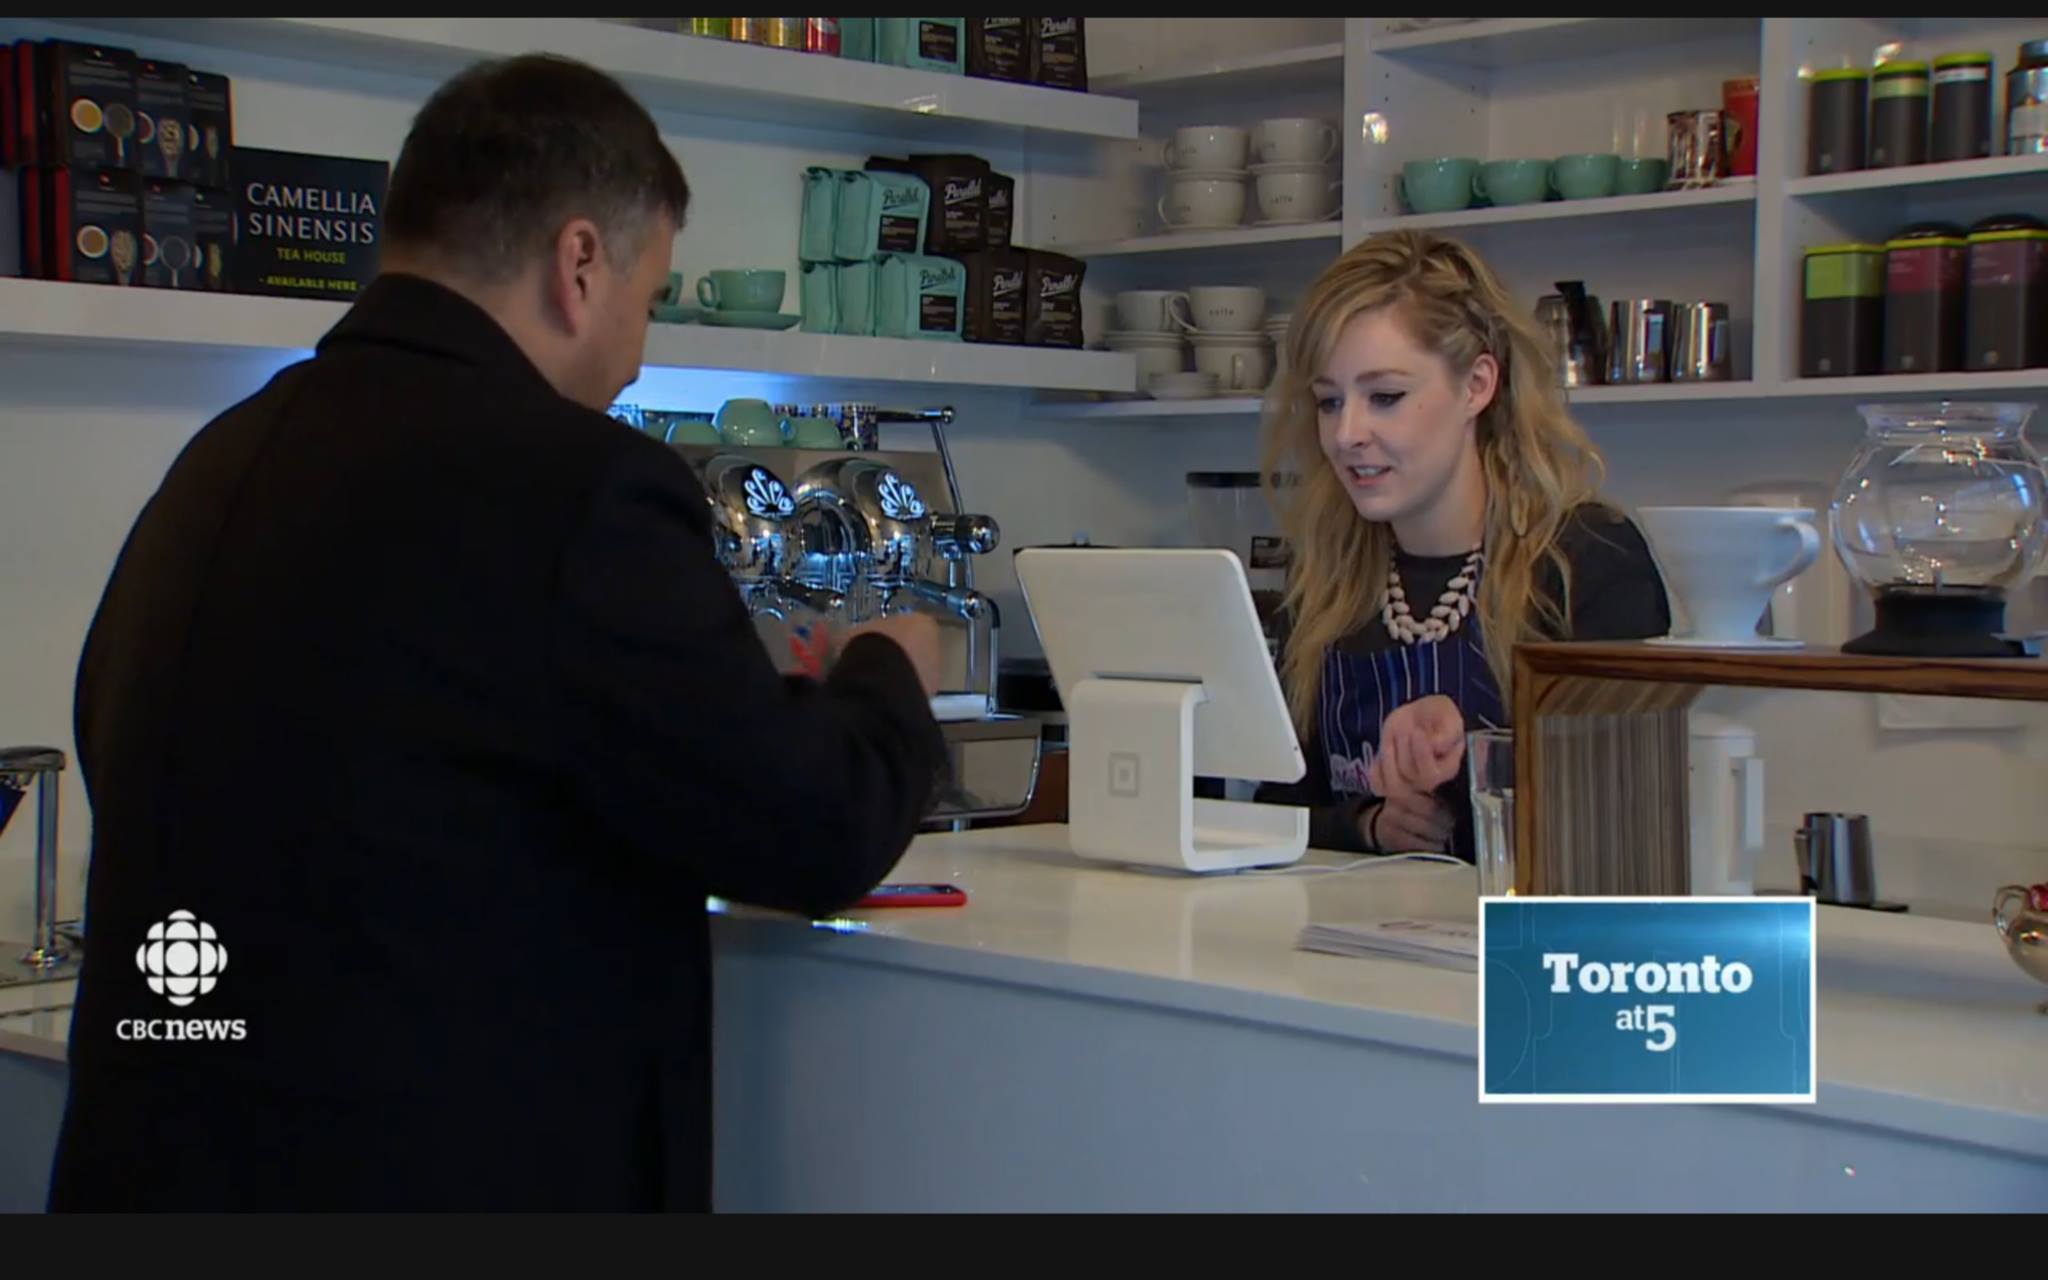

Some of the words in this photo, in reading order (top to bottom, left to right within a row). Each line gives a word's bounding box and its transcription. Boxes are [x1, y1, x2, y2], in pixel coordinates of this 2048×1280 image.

[247, 182, 376, 215] CAMELLIA
[249, 212, 374, 244] SINENSIS
[277, 247, 300, 260] TEA
[303, 250, 346, 264] HOUSE
[267, 275, 324, 289] AVAILABLE
[327, 279, 357, 291] HERE
